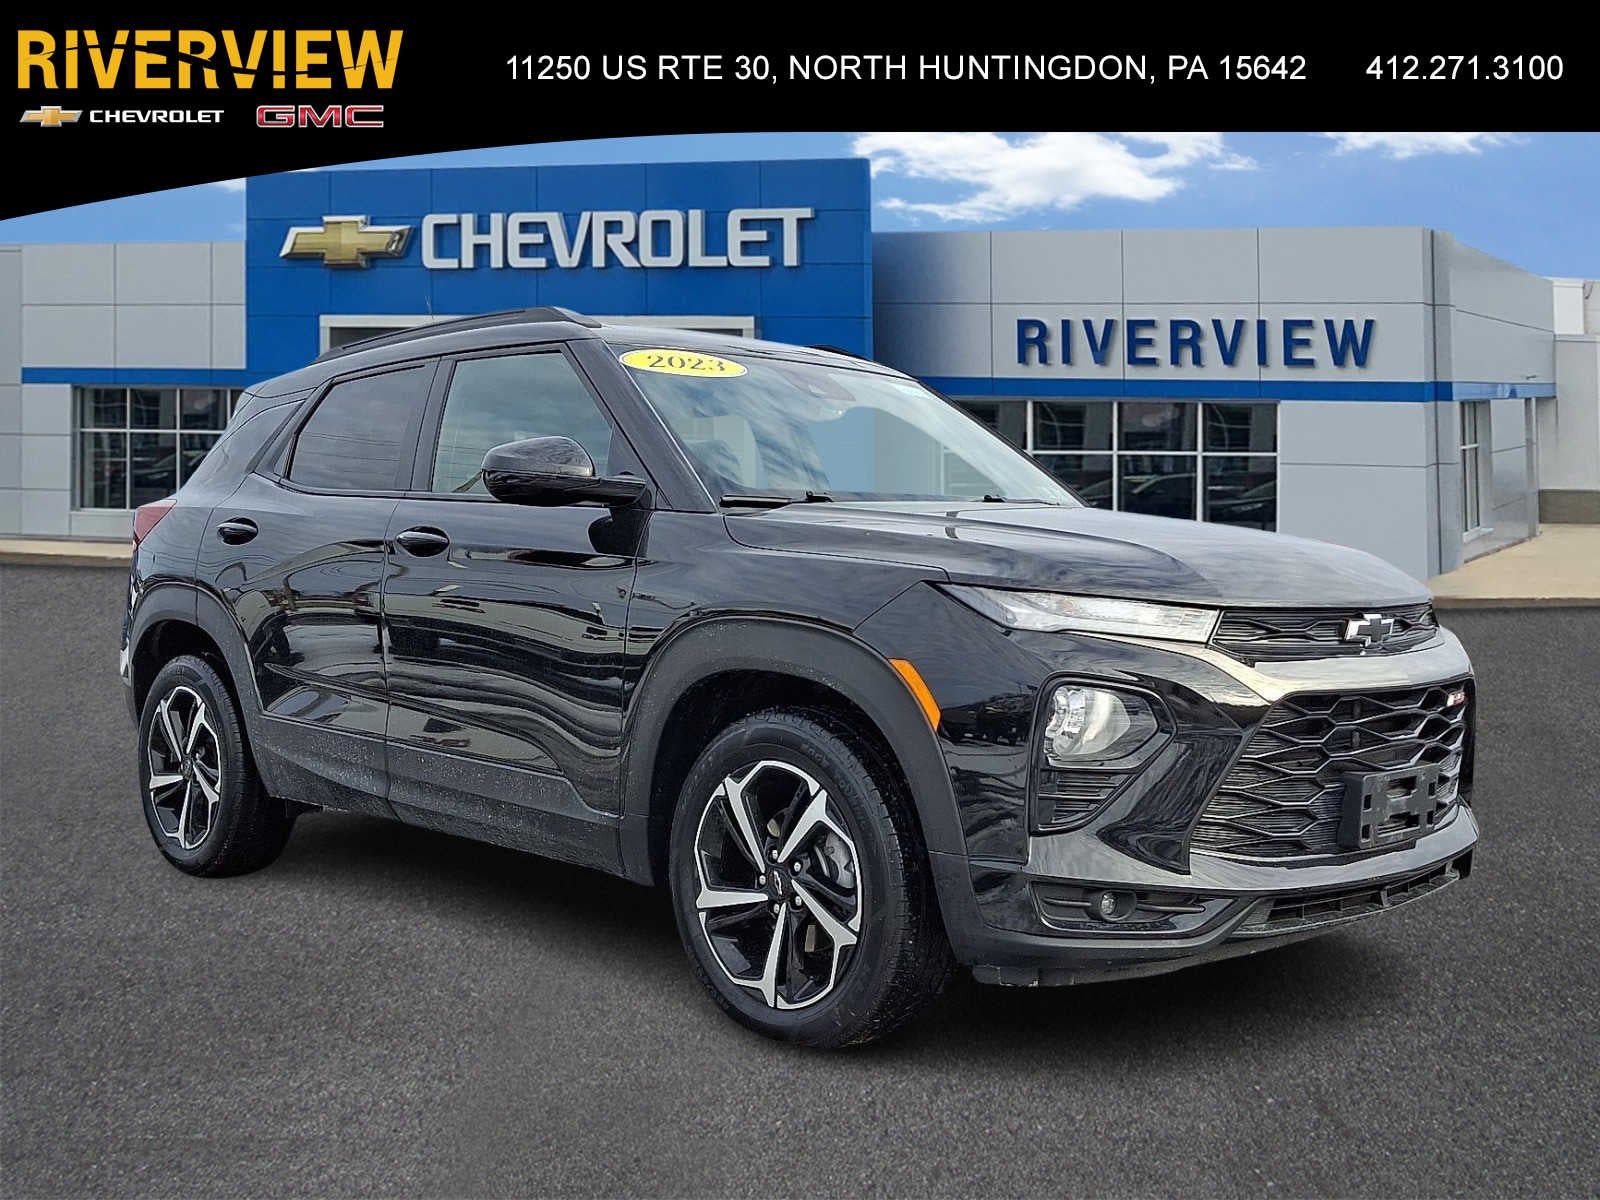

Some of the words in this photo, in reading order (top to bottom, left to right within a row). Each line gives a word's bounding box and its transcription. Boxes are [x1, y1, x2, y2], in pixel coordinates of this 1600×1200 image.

[421, 207, 814, 269] CHEVROLET
[647, 355, 725, 372] 2023
[1016, 318, 1376, 368] RIVERVIEW
